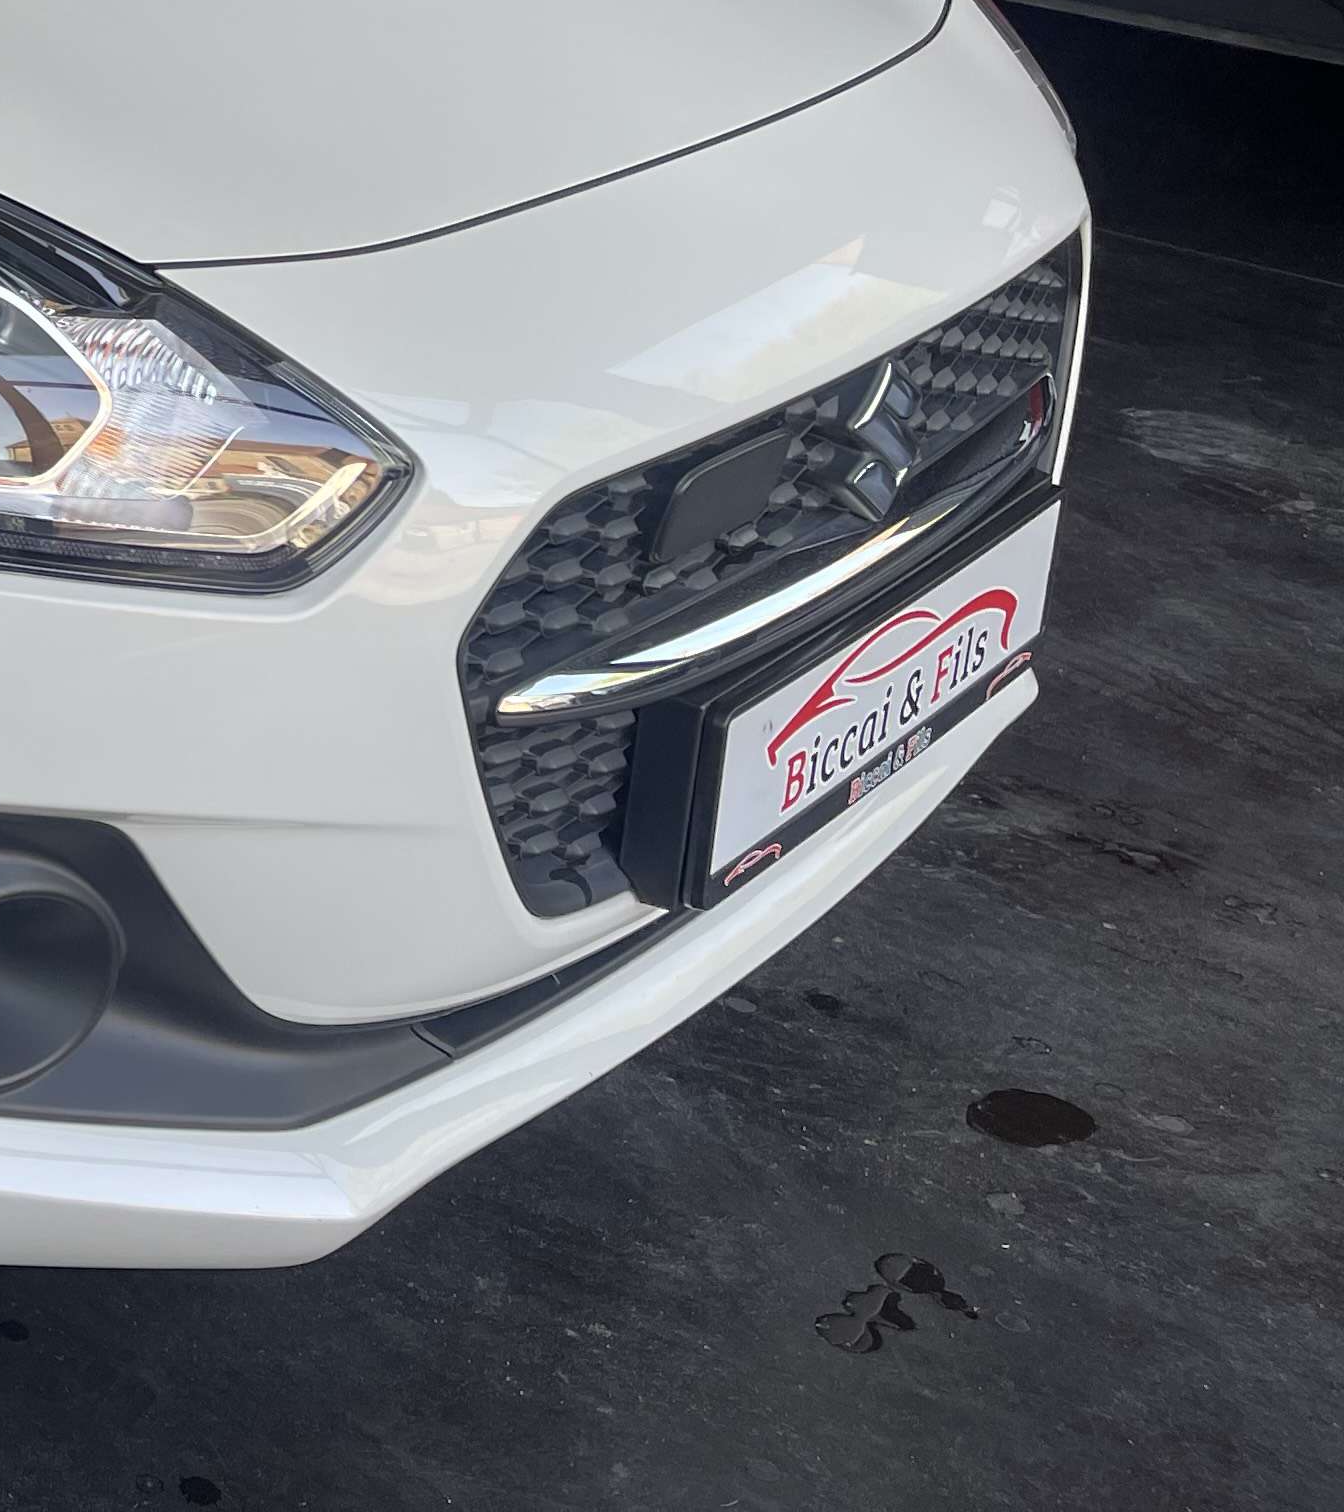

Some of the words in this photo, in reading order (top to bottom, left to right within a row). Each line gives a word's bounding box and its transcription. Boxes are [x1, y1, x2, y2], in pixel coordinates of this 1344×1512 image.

[781, 682, 894, 814] Biccai
[899, 668, 923, 728] &
[930, 626, 989, 705] Fils
[848, 750, 893, 806] Biccai
[893, 743, 905, 770] &
[905, 726, 932, 762] Fils
